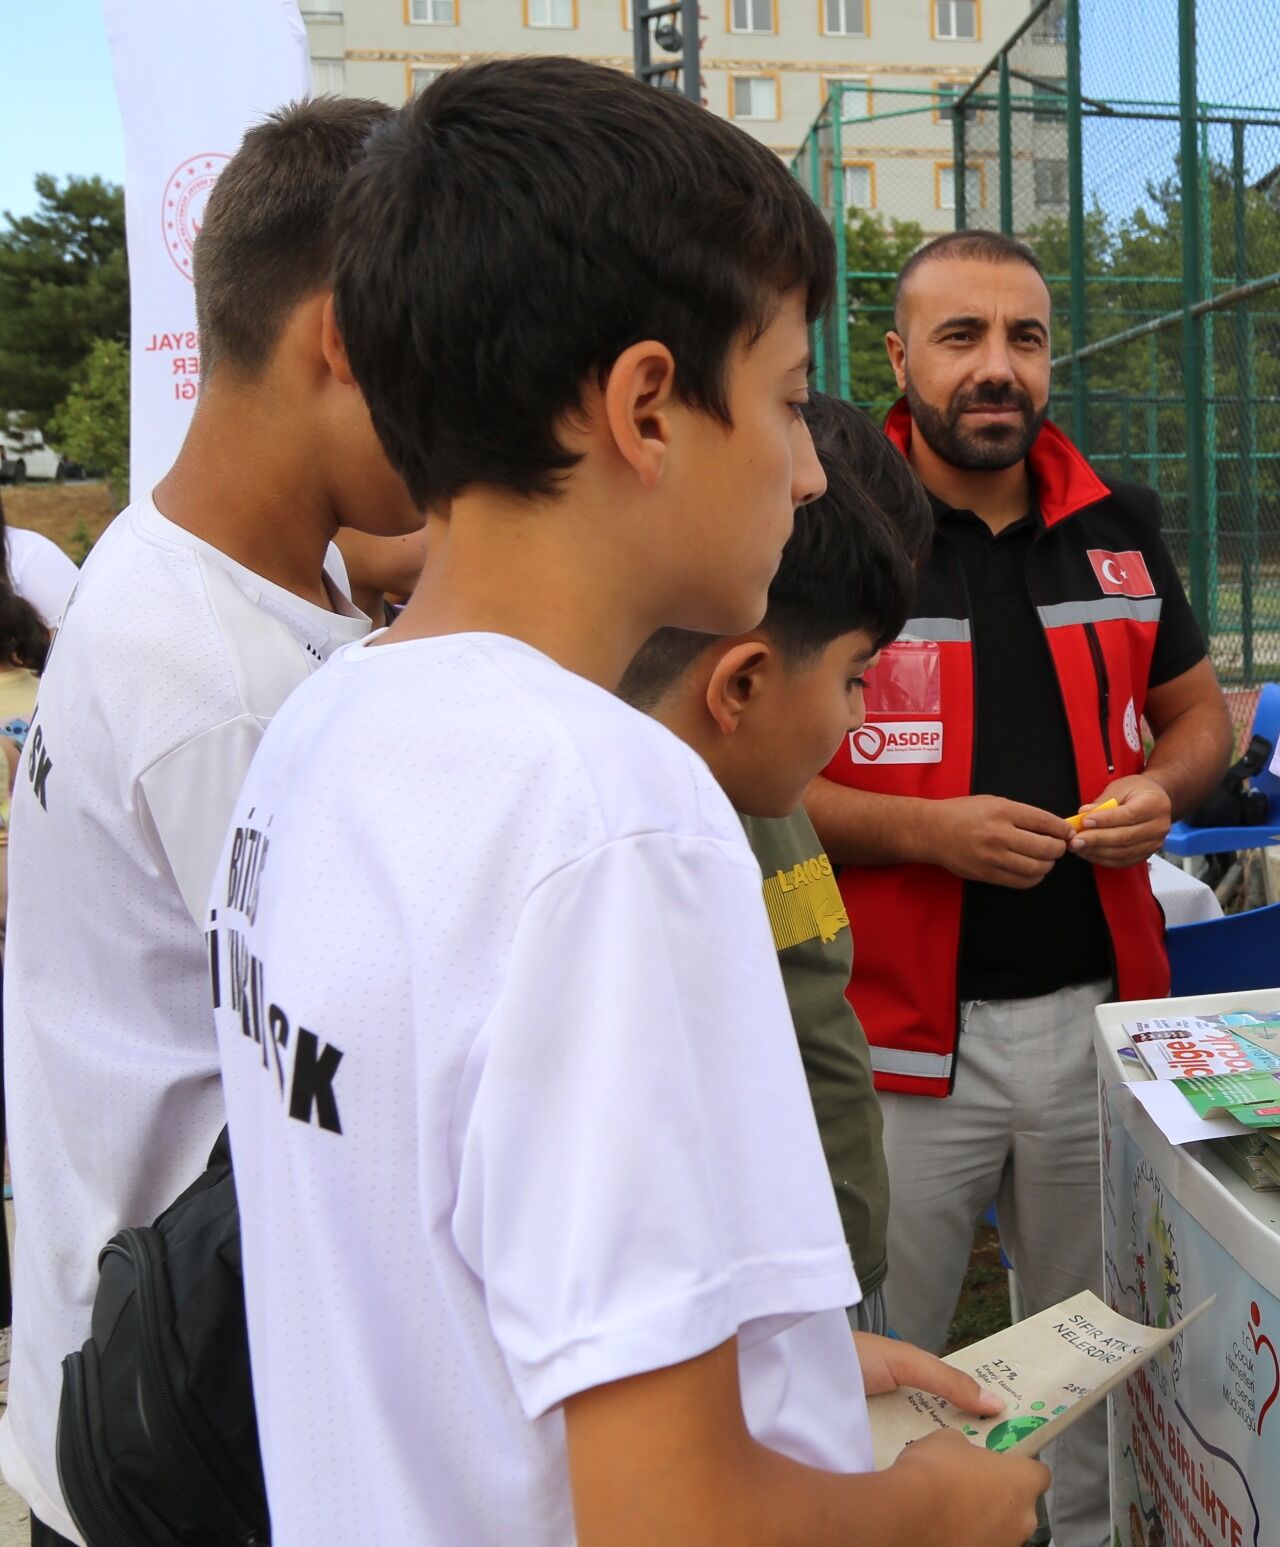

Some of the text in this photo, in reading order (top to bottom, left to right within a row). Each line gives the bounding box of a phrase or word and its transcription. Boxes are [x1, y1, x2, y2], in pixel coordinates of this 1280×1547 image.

[886, 732, 940, 747] ASDEP
[1198, 1032, 1254, 1073] ocuk
[1068, 1314, 1103, 1340] SIFIR
